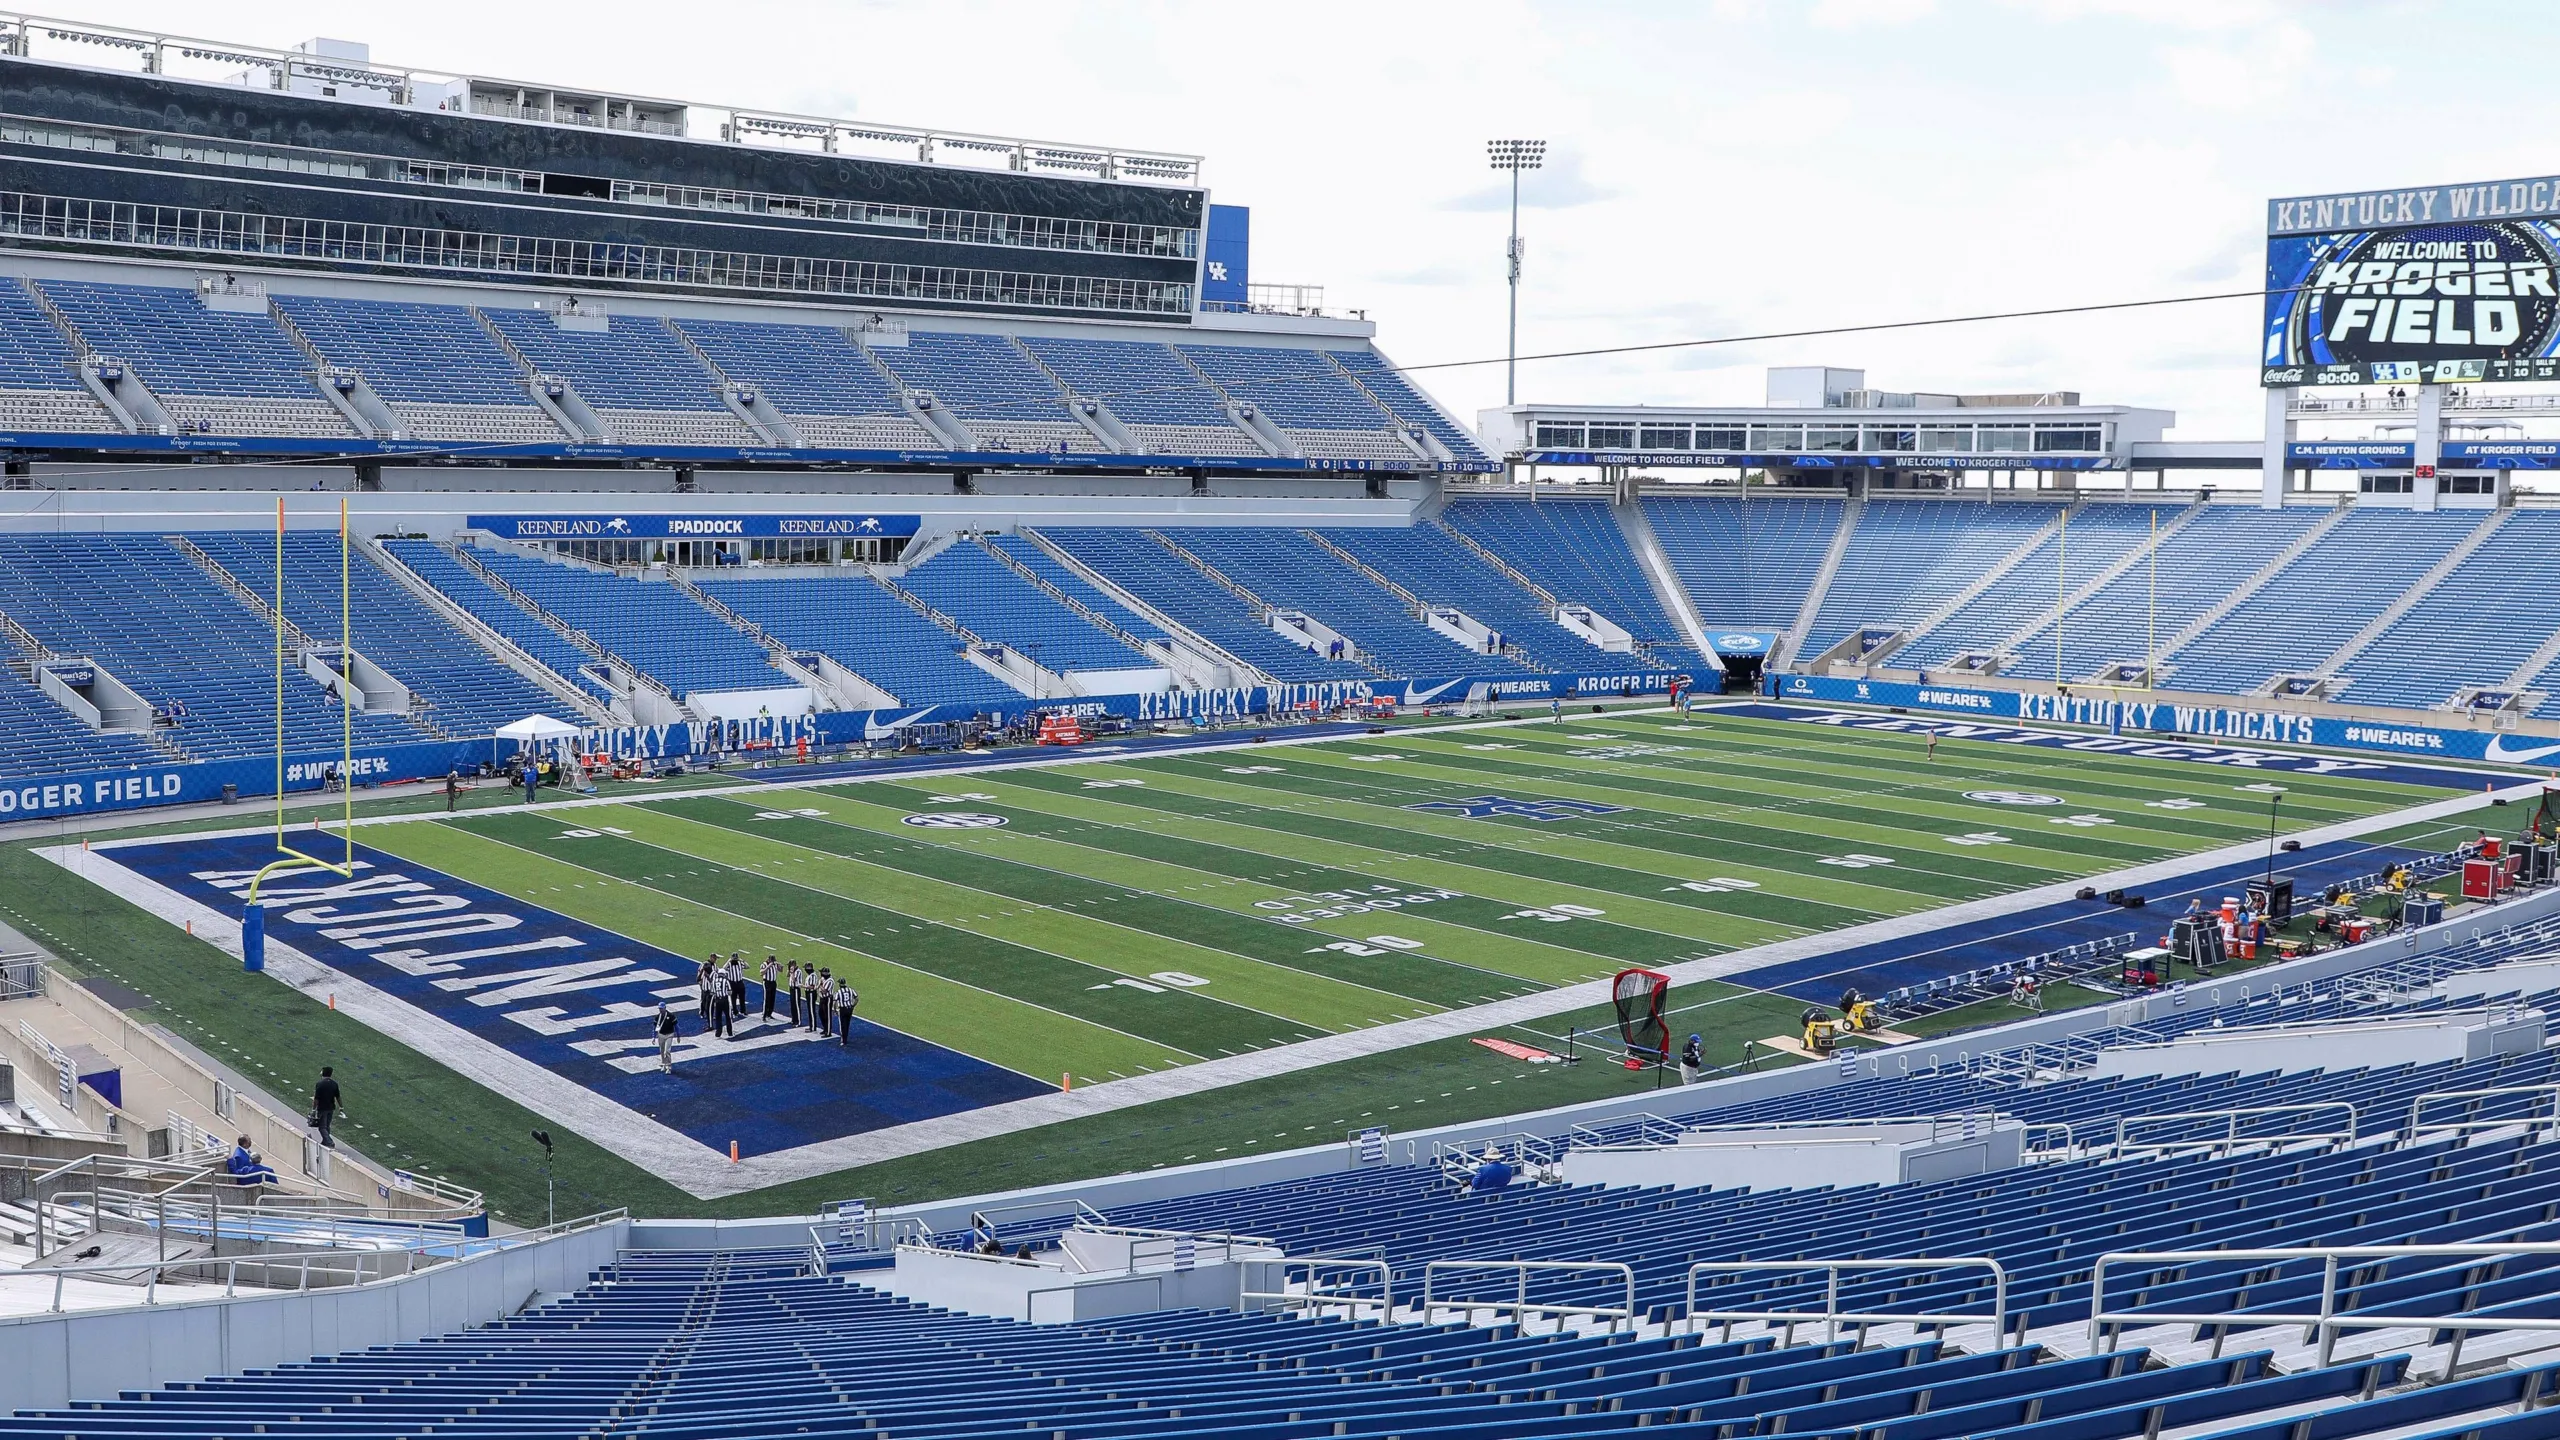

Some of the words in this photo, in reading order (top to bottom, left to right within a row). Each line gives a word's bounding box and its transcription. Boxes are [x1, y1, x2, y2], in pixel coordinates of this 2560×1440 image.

[2277, 190, 2437, 231] KENTUCKY
[2374, 242, 2466, 259] WELCOME
[2472, 241, 2497, 259] TO
[1208, 261, 1227, 281] UK
[2311, 262, 2557, 296] KROGER
[2328, 298, 2520, 346] FIELD
[2404, 367, 2412, 376] 0
[2443, 366, 2451, 375] 0
[2497, 369, 2504, 377] 1
[2514, 368, 2528, 376] 10
[2539, 367, 2553, 376] 15
[2317, 372, 2360, 384] 90:00
[171, 437, 190, 449] Kroger
[2465, 445, 2479, 454] AT
[2481, 445, 2523, 454] KROGER
[2525, 445, 2556, 454] FIELD
[2295, 446, 2314, 455] C.M.
[2316, 446, 2357, 455] NEWTON
[2358, 446, 2406, 455] GROUNDS
[1323, 460, 1329, 468] 0
[1358, 461, 1364, 469] 0
[1383, 462, 1410, 470] 90:00
[1594, 454, 1637, 463] WELCOME
[1639, 455, 1650, 464] TO
[1653, 455, 1693, 464] KROGER
[1695, 456, 1725, 465] FIELD
[1896, 457, 1950, 467] WELCOME
[1953, 458, 1966, 467] TO
[1968, 458, 2006, 467] KROGER
[2008, 458, 2032, 467] FIELD
[1462, 463, 1472, 471] 10
[2416, 466, 2434, 478] 25
[517, 520, 601, 535] KEENELAND
[675, 520, 743, 533] PADDOCK
[779, 520, 854, 533] KEENELAND
[1578, 675, 1640, 692] KROGER
[1645, 674, 1693, 689] FIE
[1139, 687, 1253, 720] KENTUCKY
[1266, 680, 1367, 713] WILDCATS
[2173, 706, 2313, 744] WILDCATS
[1798, 713, 2388, 772] KENTUCKY
[95, 774, 181, 803] FIELD
[562, 827, 630, 837] 10
[1814, 854, 1893, 868] 50
[1678, 877, 1757, 892] 40
[1514, 904, 1603, 921] 30
[1323, 935, 1422, 956] 20
[190, 860, 840, 1075] KENTUCKY
[1112, 971, 1209, 993] 10
